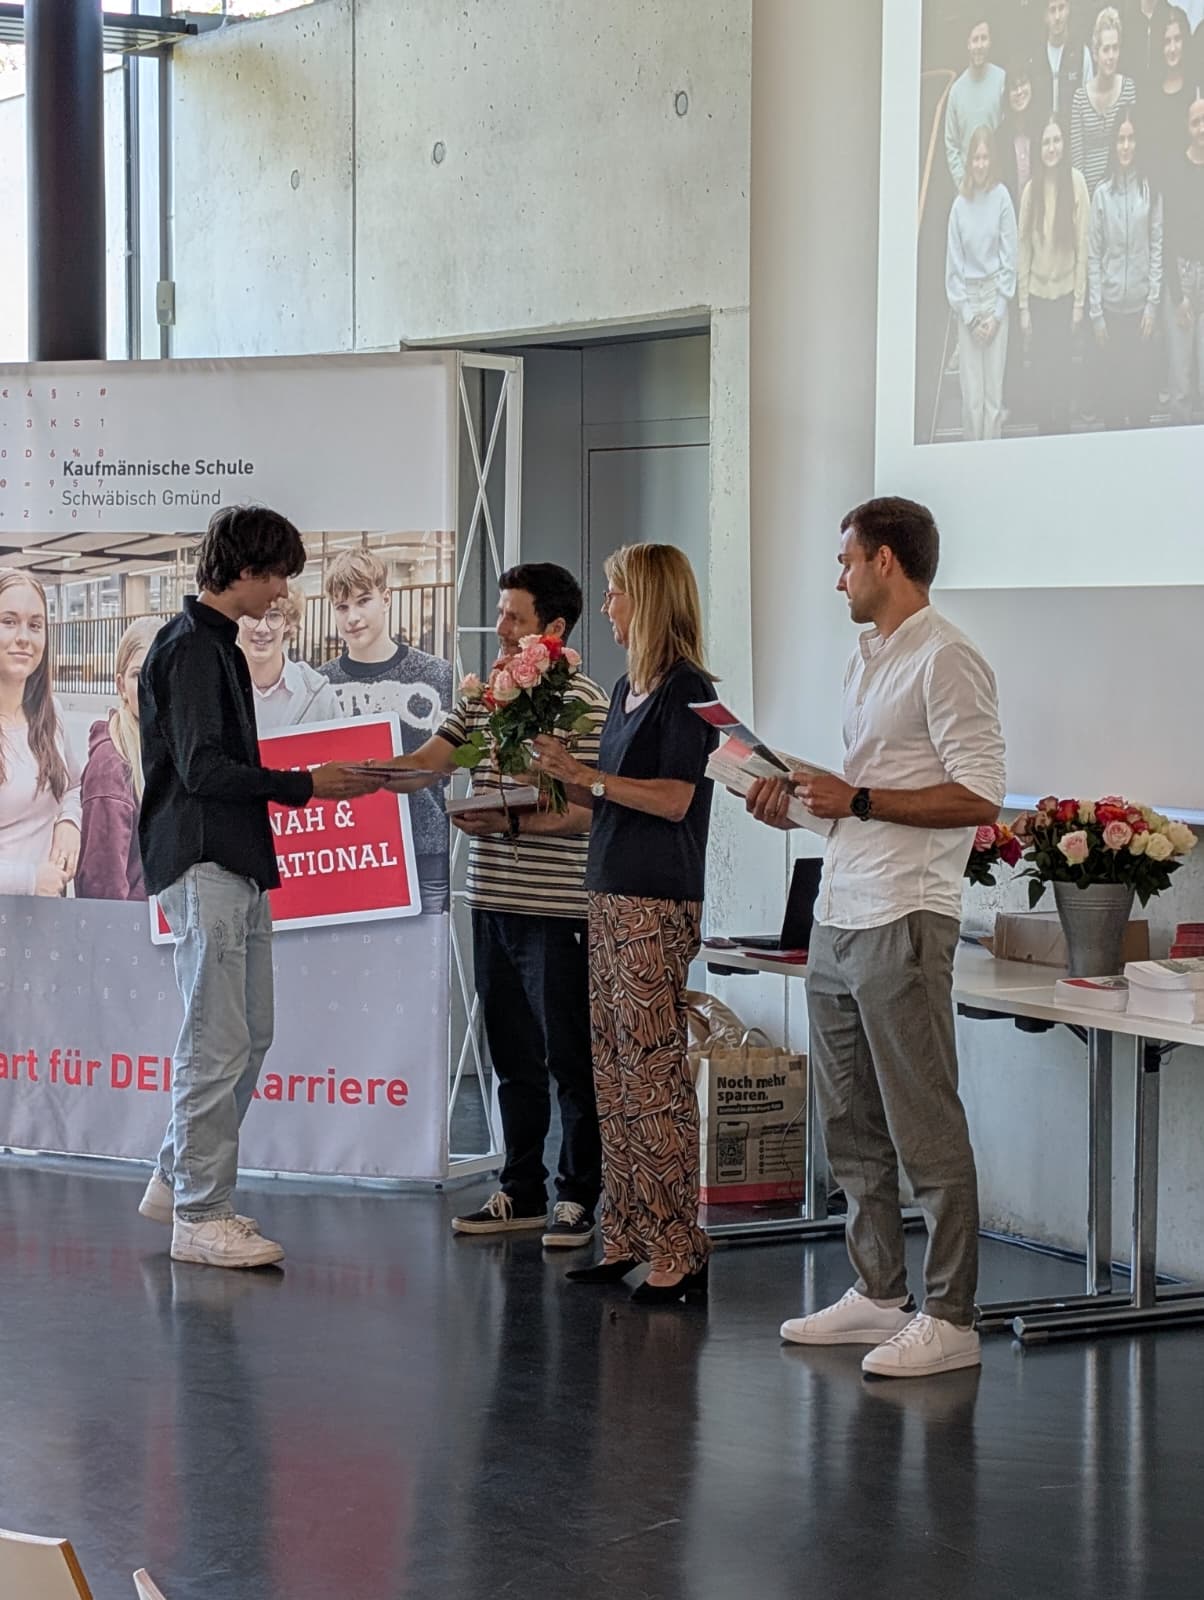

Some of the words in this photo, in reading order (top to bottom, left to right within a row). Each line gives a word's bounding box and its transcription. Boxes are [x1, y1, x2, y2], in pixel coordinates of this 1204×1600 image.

[26, 419, 32, 428] 3
[50, 419, 57, 428] K
[74, 418, 80, 427] S
[25, 449, 32, 458] D
[63, 460, 190, 476] Kaufmännische
[195, 459, 254, 475] Schule
[62, 490, 156, 505] Schwäbisch
[163, 488, 221, 505] Gmünd
[335, 800, 355, 828] &
[276, 842, 397, 878] ATIONAL
[49, 1049, 102, 1086] für
[111, 1053, 171, 1092] DEI
[717, 1076, 752, 1088] Noch
[756, 1074, 786, 1088] mehr
[717, 1091, 769, 1104] sparen.
